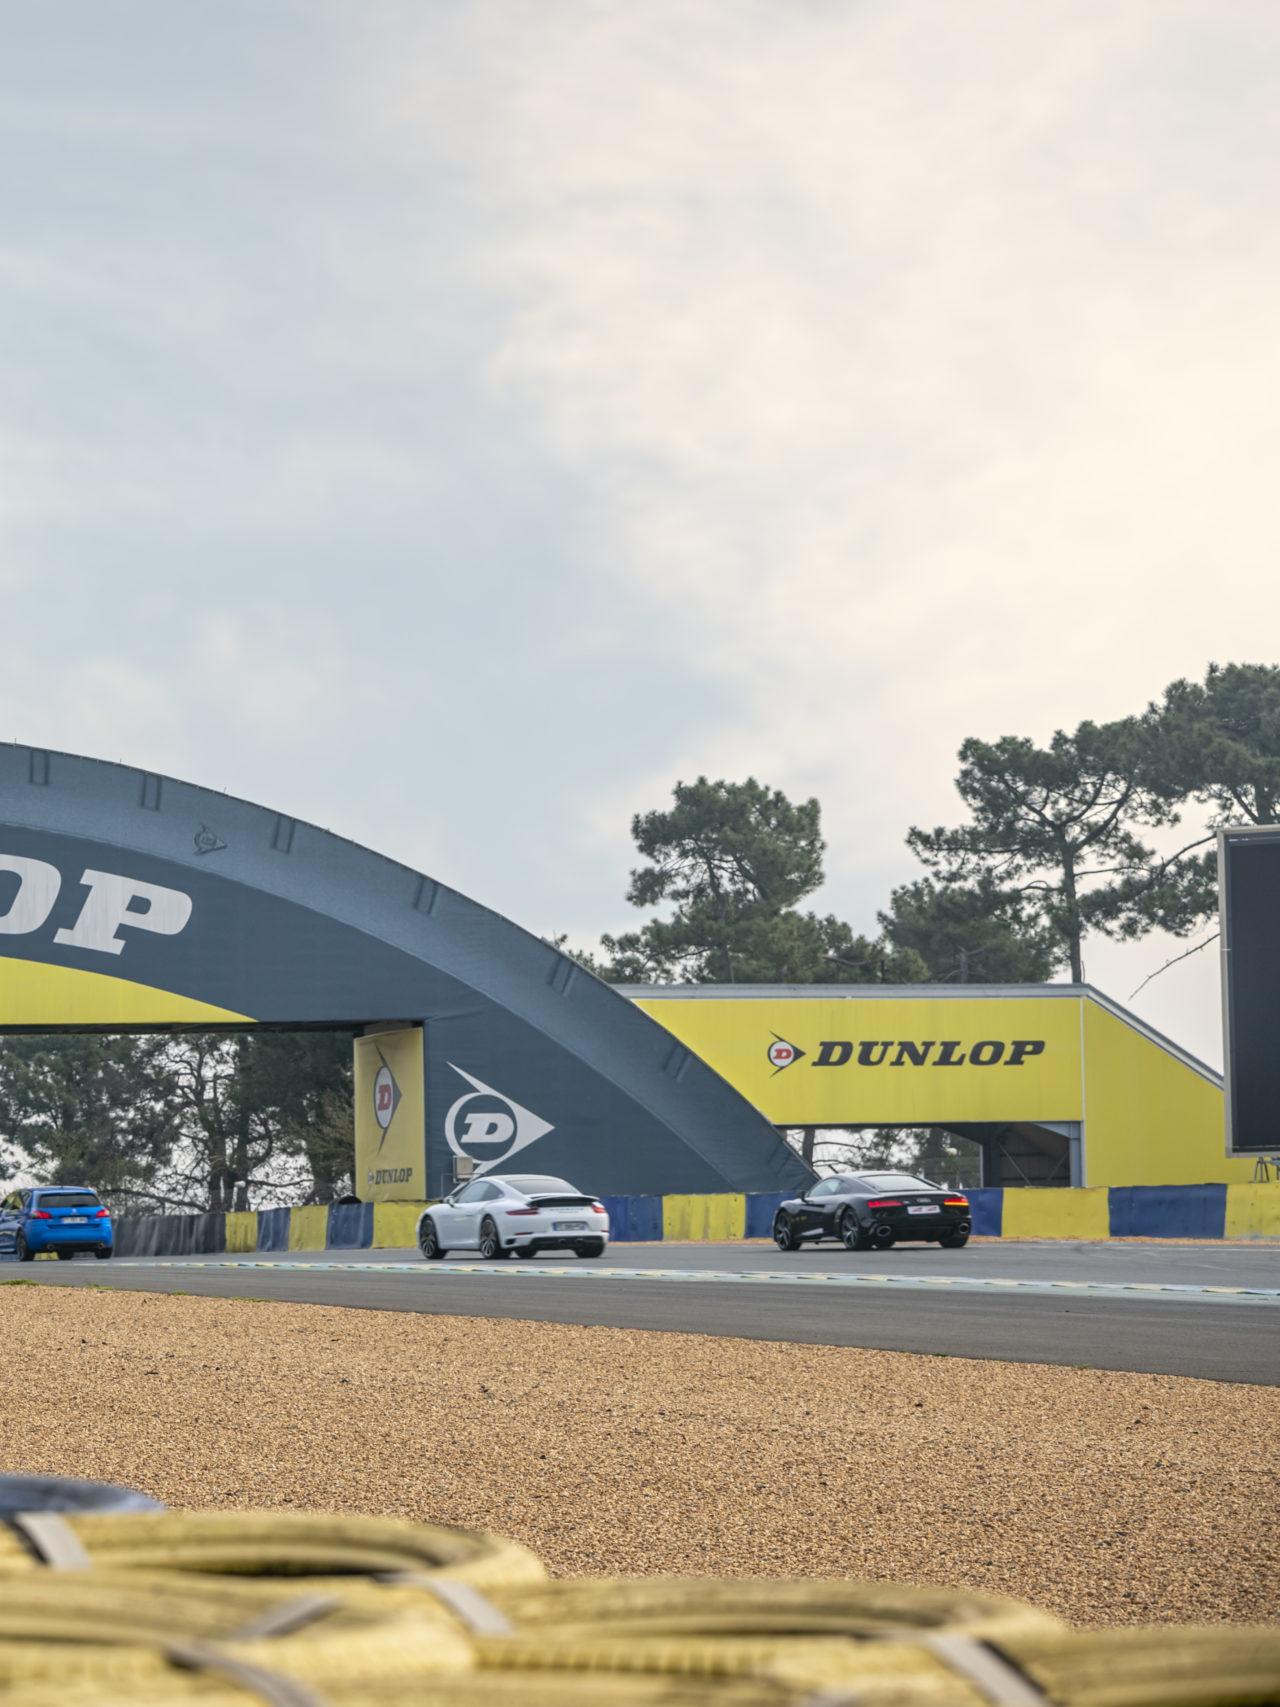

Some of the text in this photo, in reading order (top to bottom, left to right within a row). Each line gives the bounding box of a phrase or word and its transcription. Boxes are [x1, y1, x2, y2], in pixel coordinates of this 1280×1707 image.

[773, 1040, 1046, 1066] D DUNLOP
[377, 1085, 392, 1111] D
[460, 1112, 515, 1143] D
